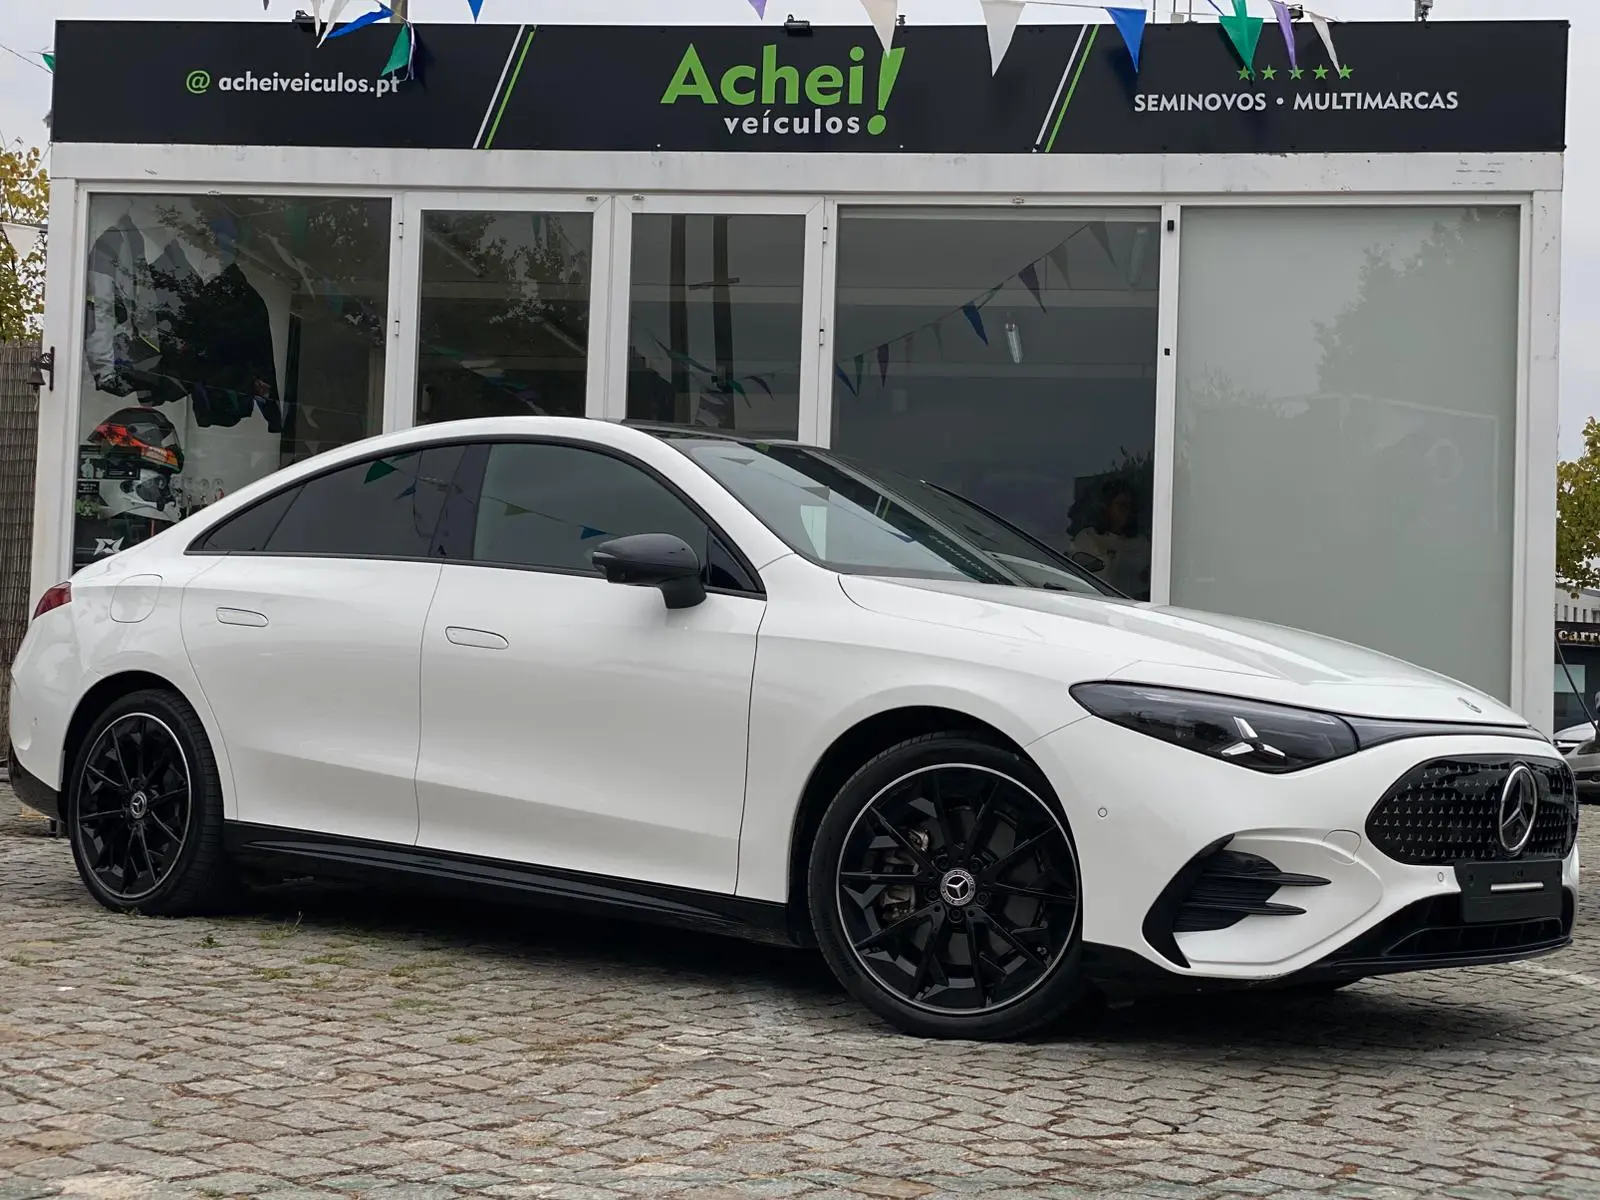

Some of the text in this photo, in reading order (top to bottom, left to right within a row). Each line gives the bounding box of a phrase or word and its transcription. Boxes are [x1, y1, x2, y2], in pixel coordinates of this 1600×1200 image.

[218, 71, 400, 97] acheiveiculos.pt
[1134, 91, 1459, 112] SEMINOVOS MULTIMARCAS
[724, 108, 860, 134] veículos
[1558, 630, 1600, 642] carr
